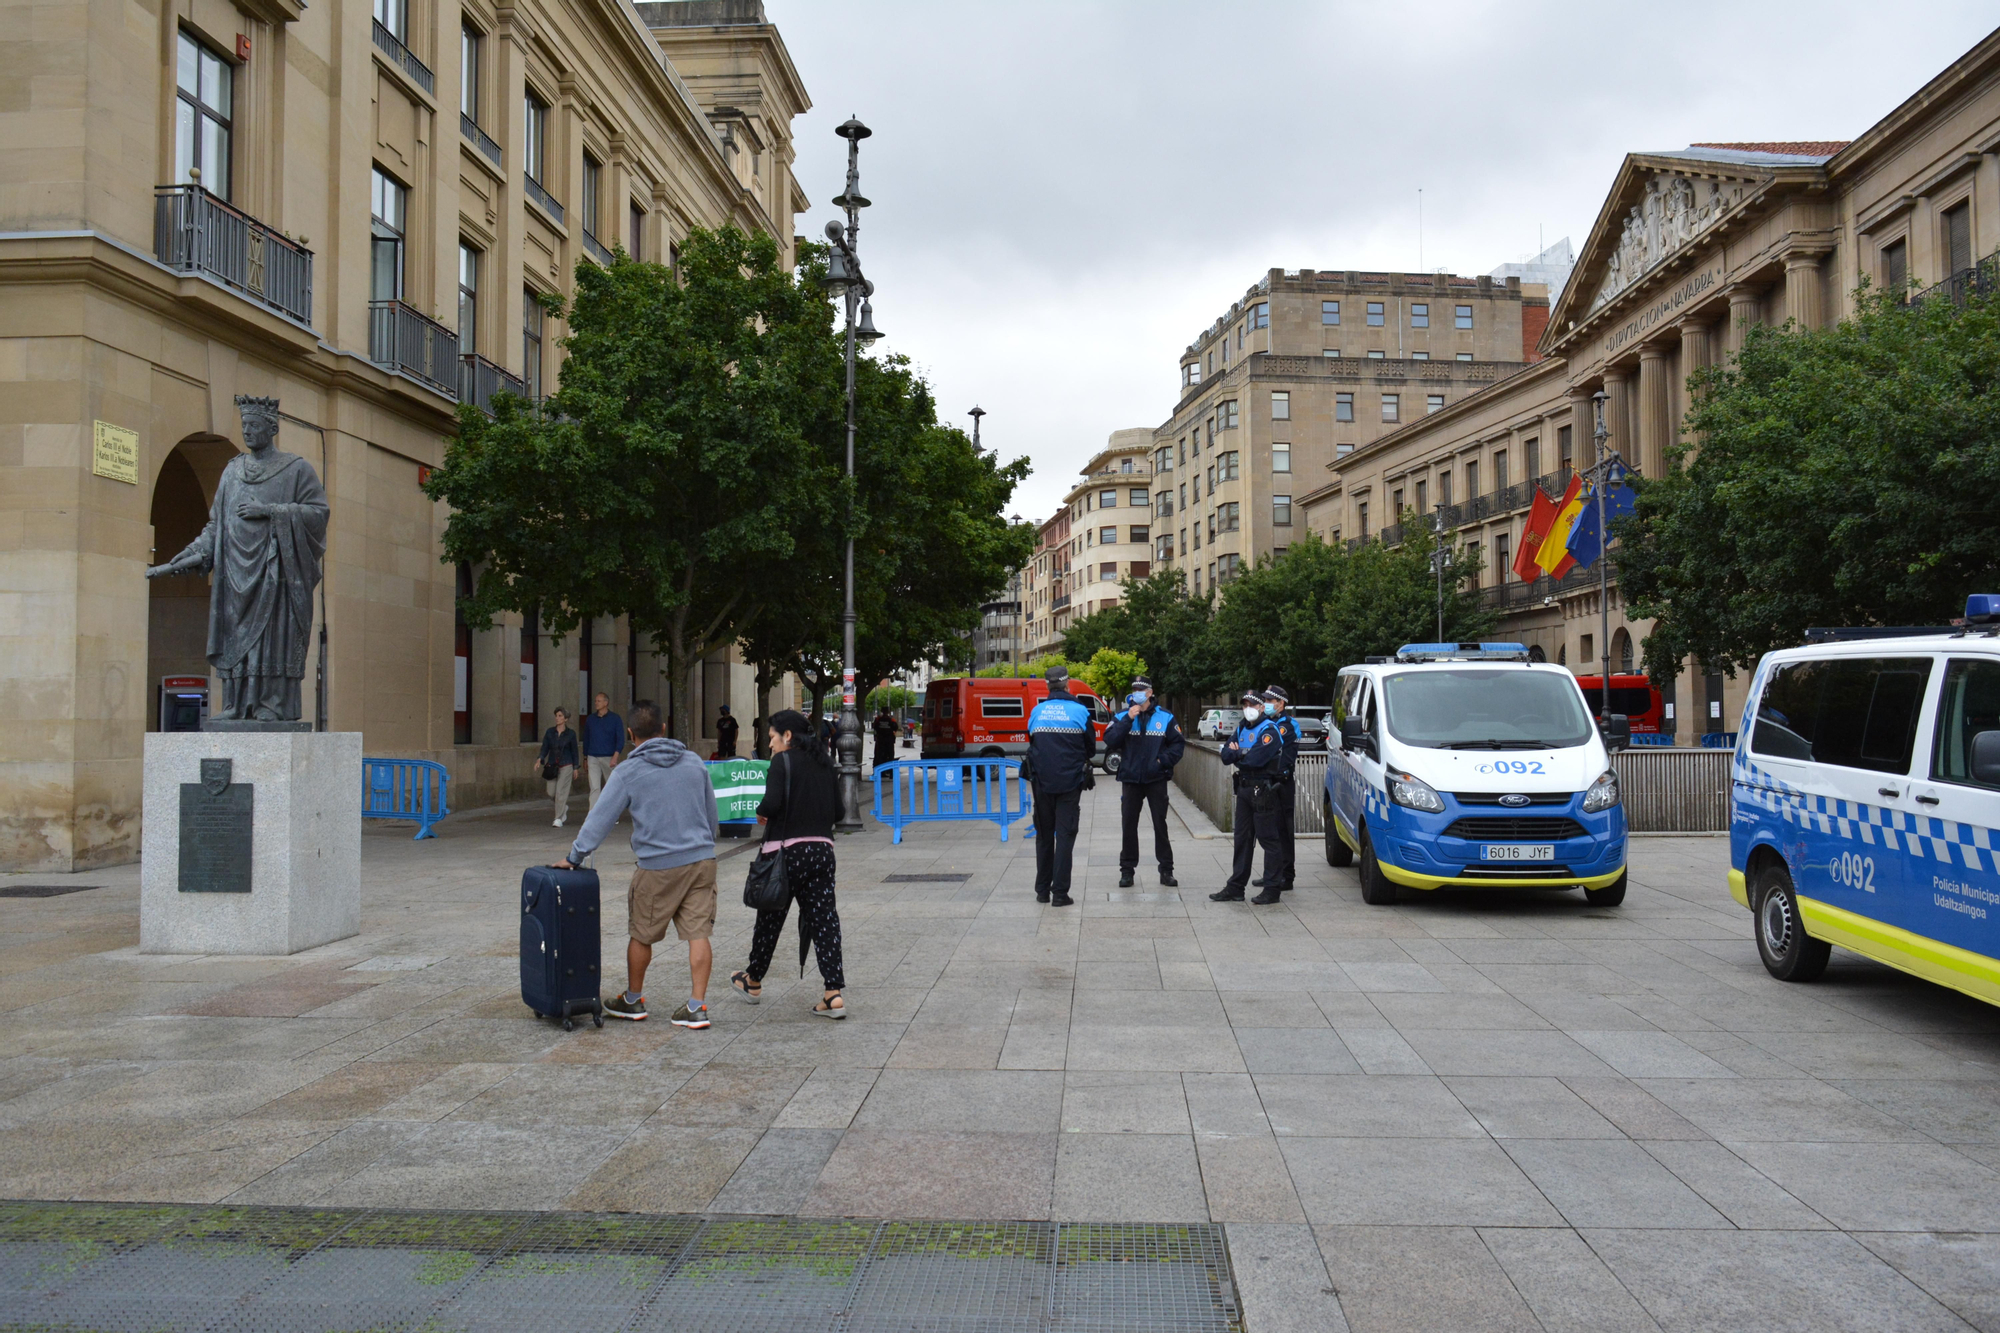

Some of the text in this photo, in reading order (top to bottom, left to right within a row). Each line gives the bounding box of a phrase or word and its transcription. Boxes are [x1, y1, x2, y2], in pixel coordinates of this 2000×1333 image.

[1670, 269, 1715, 311] NAVARRA
[102, 438, 112, 450] Carlos
[122, 444, 132, 455] Noble
[99, 450, 110, 461] Karlos
[973, 735, 994, 743] BCI-02
[1494, 760, 1546, 775] 092
[730, 770, 765, 782] SALIDA
[730, 800, 760, 812] IRTEER
[1506, 796, 1524, 804] Ford
[1490, 847, 1551, 859] 6016 JYF
[1841, 851, 1876, 894] 092
[1933, 875, 2000, 905] Policía Municipa
[1933, 893, 1987, 919] Udaltzaingoa
